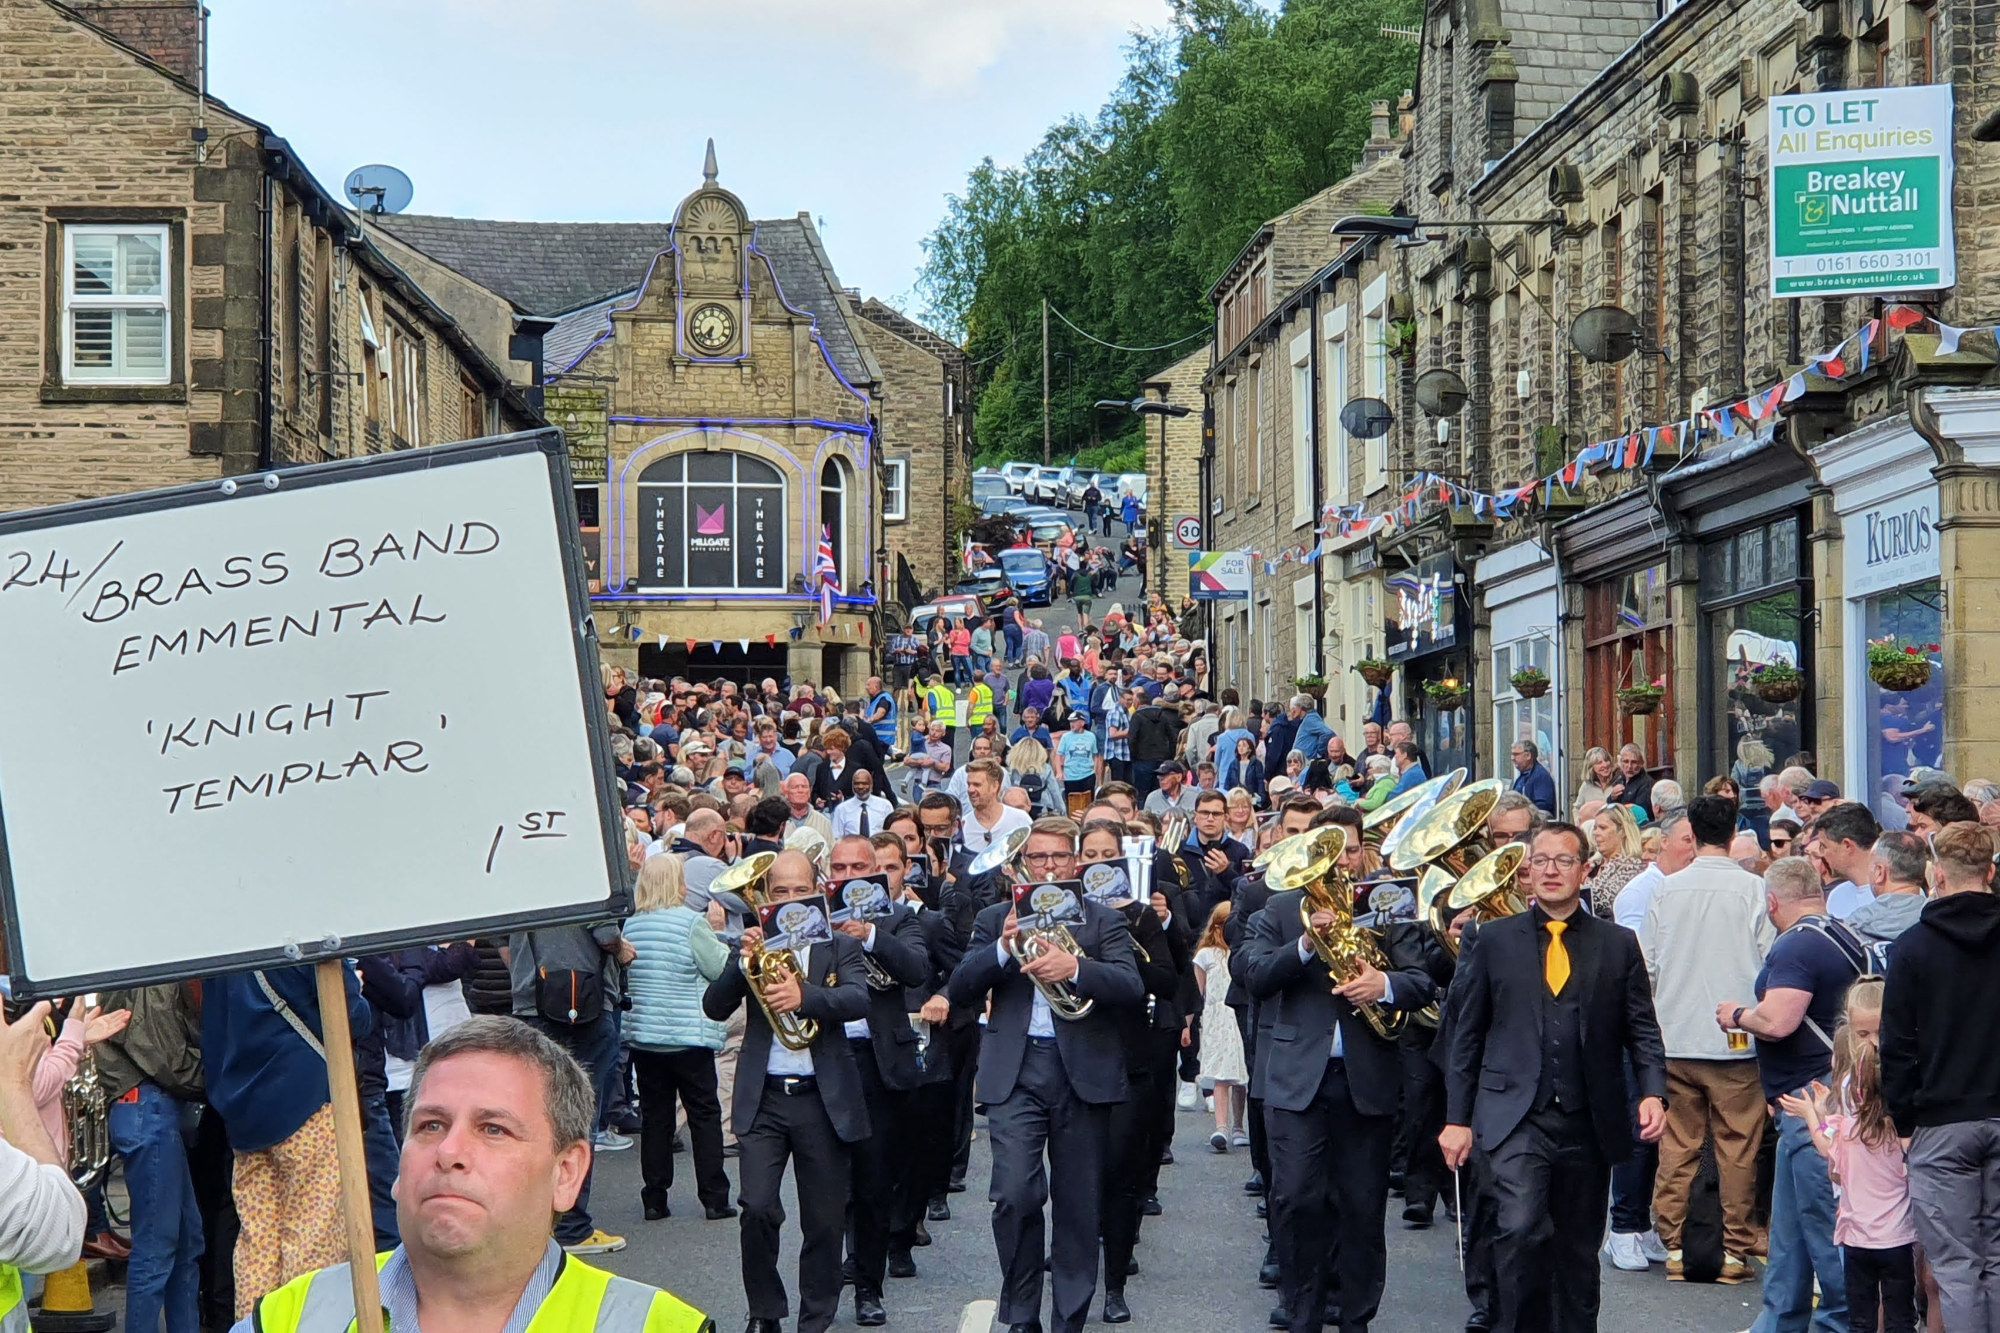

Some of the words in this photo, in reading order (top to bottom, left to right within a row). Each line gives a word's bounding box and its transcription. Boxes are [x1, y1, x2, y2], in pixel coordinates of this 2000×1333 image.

[1776, 104, 1815, 128] TO
[1826, 99, 1879, 125] LET
[1777, 132, 1807, 154] All
[1815, 126, 1934, 153] Enquiries
[1807, 165, 1906, 194] Breakey
[1804, 200, 1826, 223] &
[1831, 188, 1919, 216] Nuttall
[1816, 257, 1851, 273] 0161
[1859, 254, 1890, 270] 660
[1895, 252, 1932, 268] 3101
[1789, 273, 1925, 289] www.breakeynuttall.co.uk
[656, 497, 664, 578] THEATRE
[690, 537, 730, 547] MILLGATE
[755, 498, 764, 579] THEATRE
[1181, 525, 1200, 538] 30
[1865, 505, 1932, 566] KURIOS
[320, 522, 500, 577] BAND
[1225, 559, 1244, 567] FOR
[1220, 567, 1244, 575] SALE
[113, 594, 447, 676] EMMENTAL
